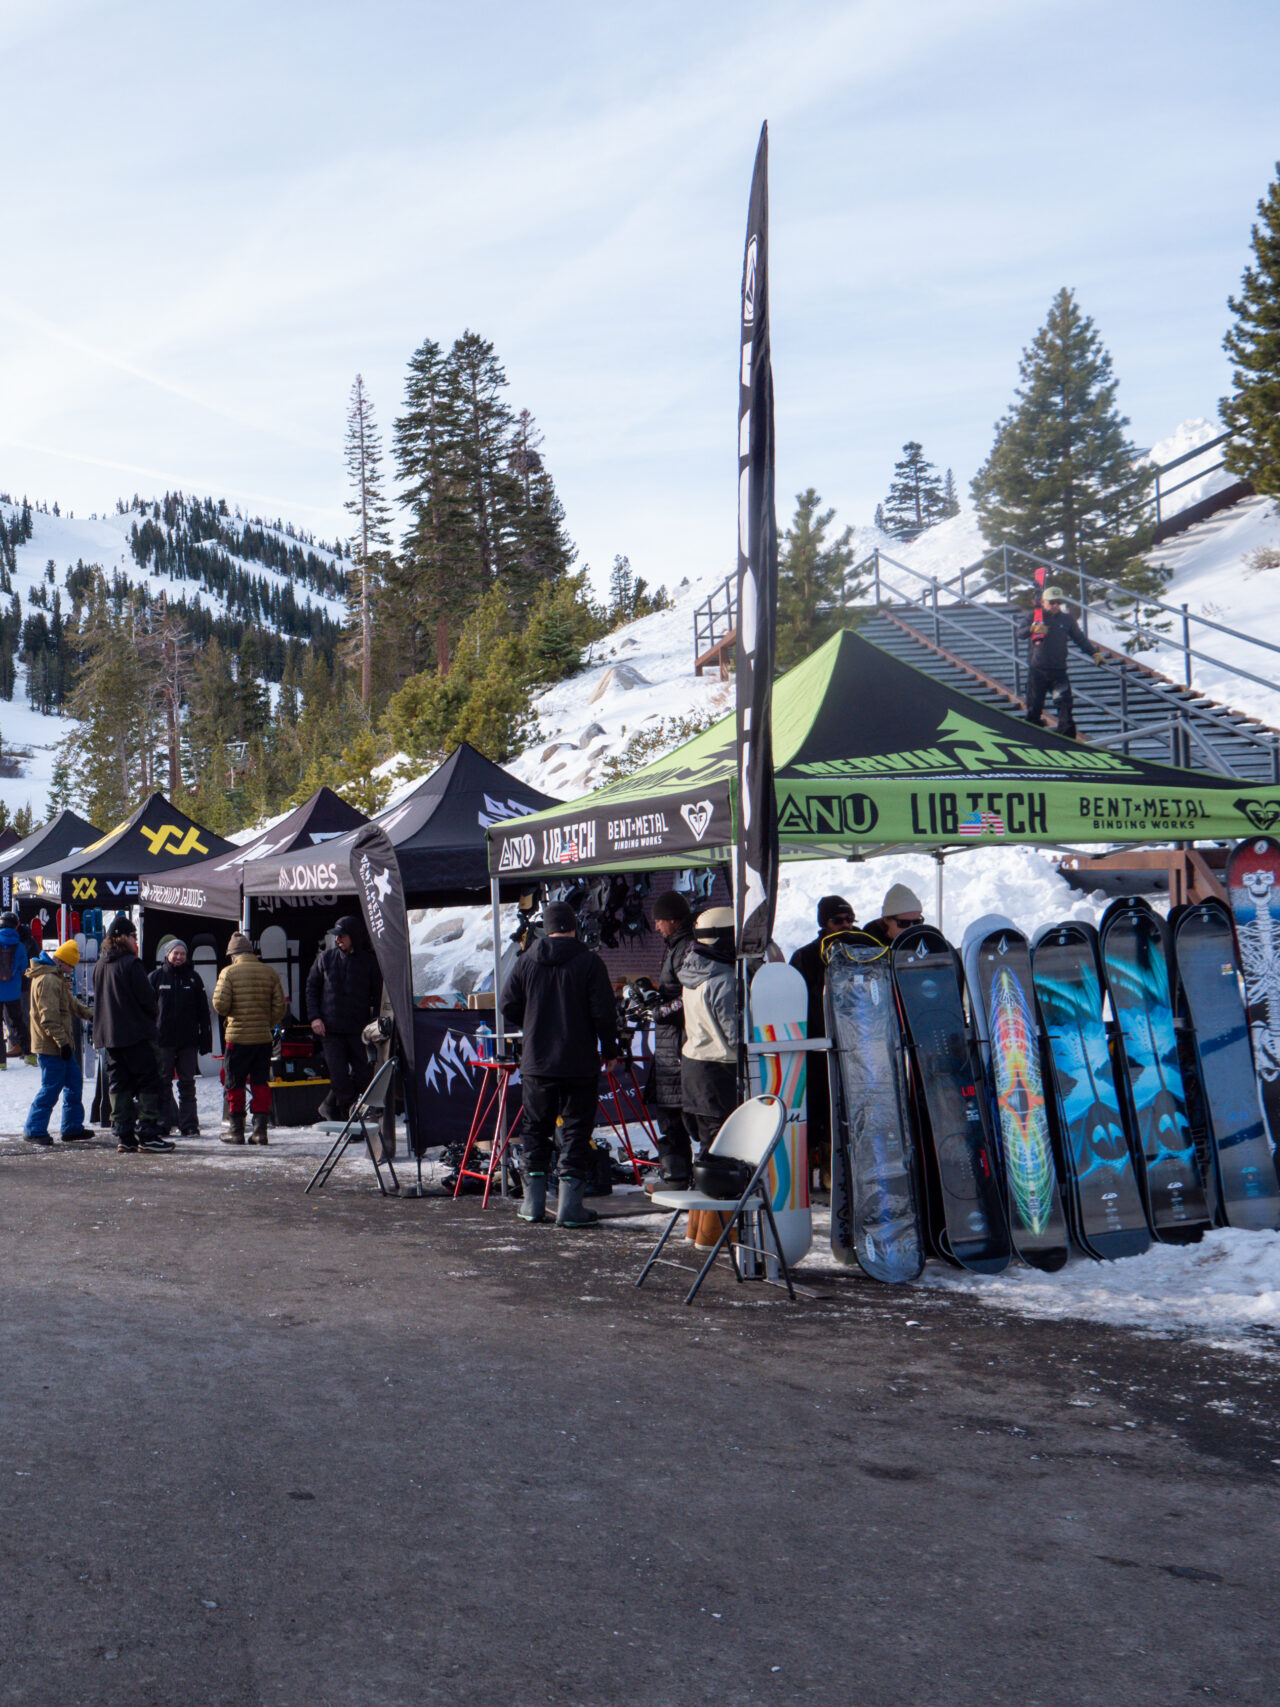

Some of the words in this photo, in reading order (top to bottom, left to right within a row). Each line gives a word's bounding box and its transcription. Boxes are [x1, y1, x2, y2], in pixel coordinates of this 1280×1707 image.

[791, 748, 957, 775] MERVIN
[1008, 747, 1135, 770] MADE
[1093, 820, 1146, 830] BINDING
[1151, 820, 1195, 830] WORKS
[614, 838, 639, 850] BINDING
[641, 836, 662, 847] WORKS
[150, 885, 181, 905] PREMIUM
[179, 888, 204, 908] GOODS
